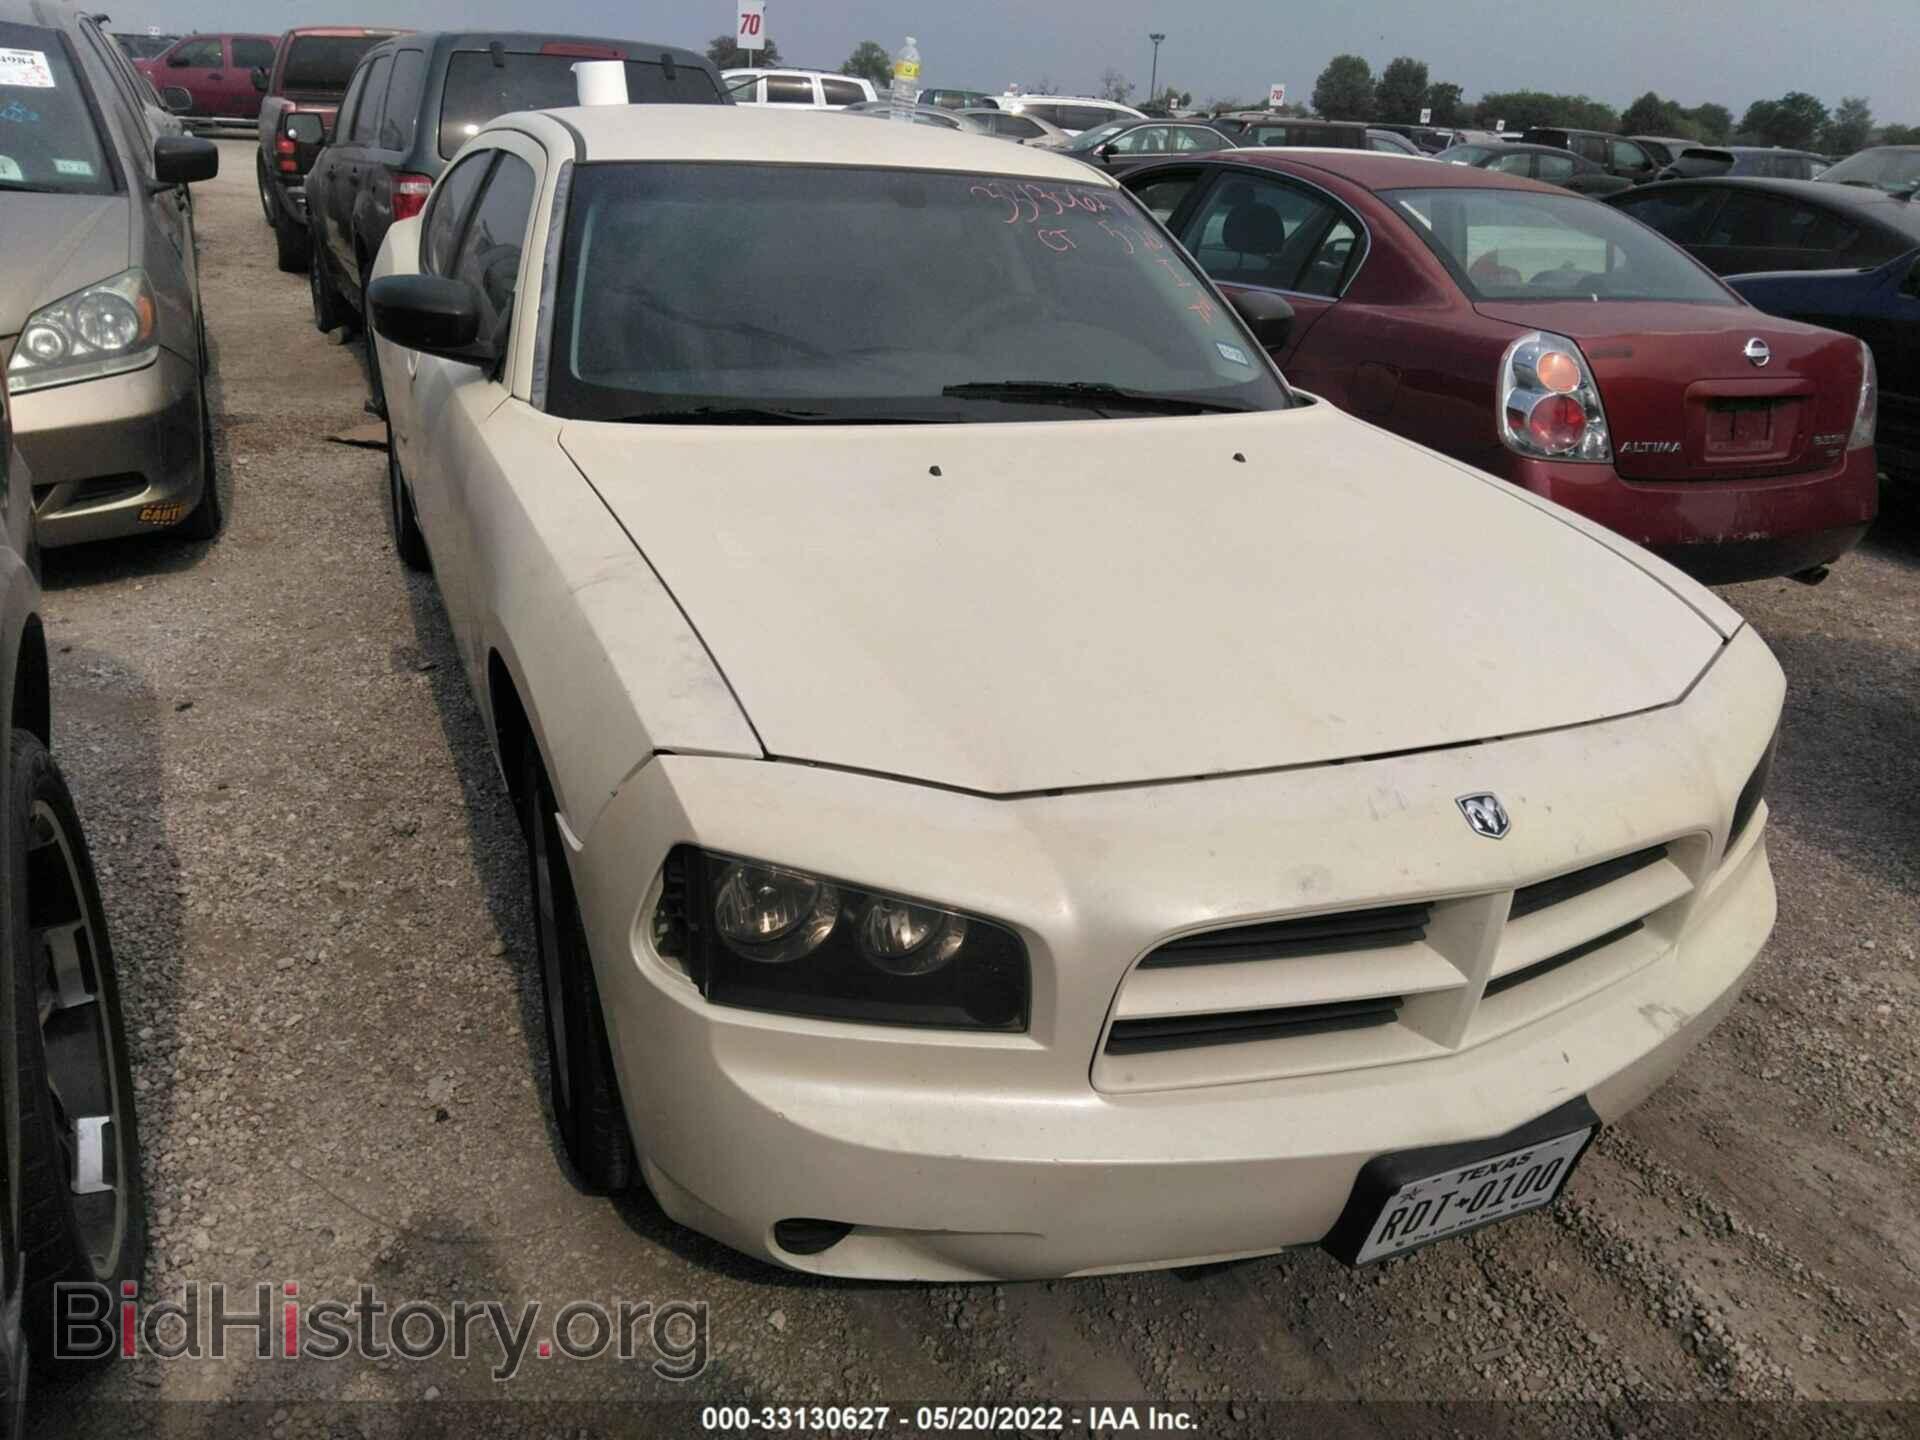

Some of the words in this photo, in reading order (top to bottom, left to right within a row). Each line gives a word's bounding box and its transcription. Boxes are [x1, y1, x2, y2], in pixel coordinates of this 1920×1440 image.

[740, 13, 761, 35] 70
[1619, 441, 1681, 453] ALTIMA
[1457, 1151, 1534, 1184] TEXAS
